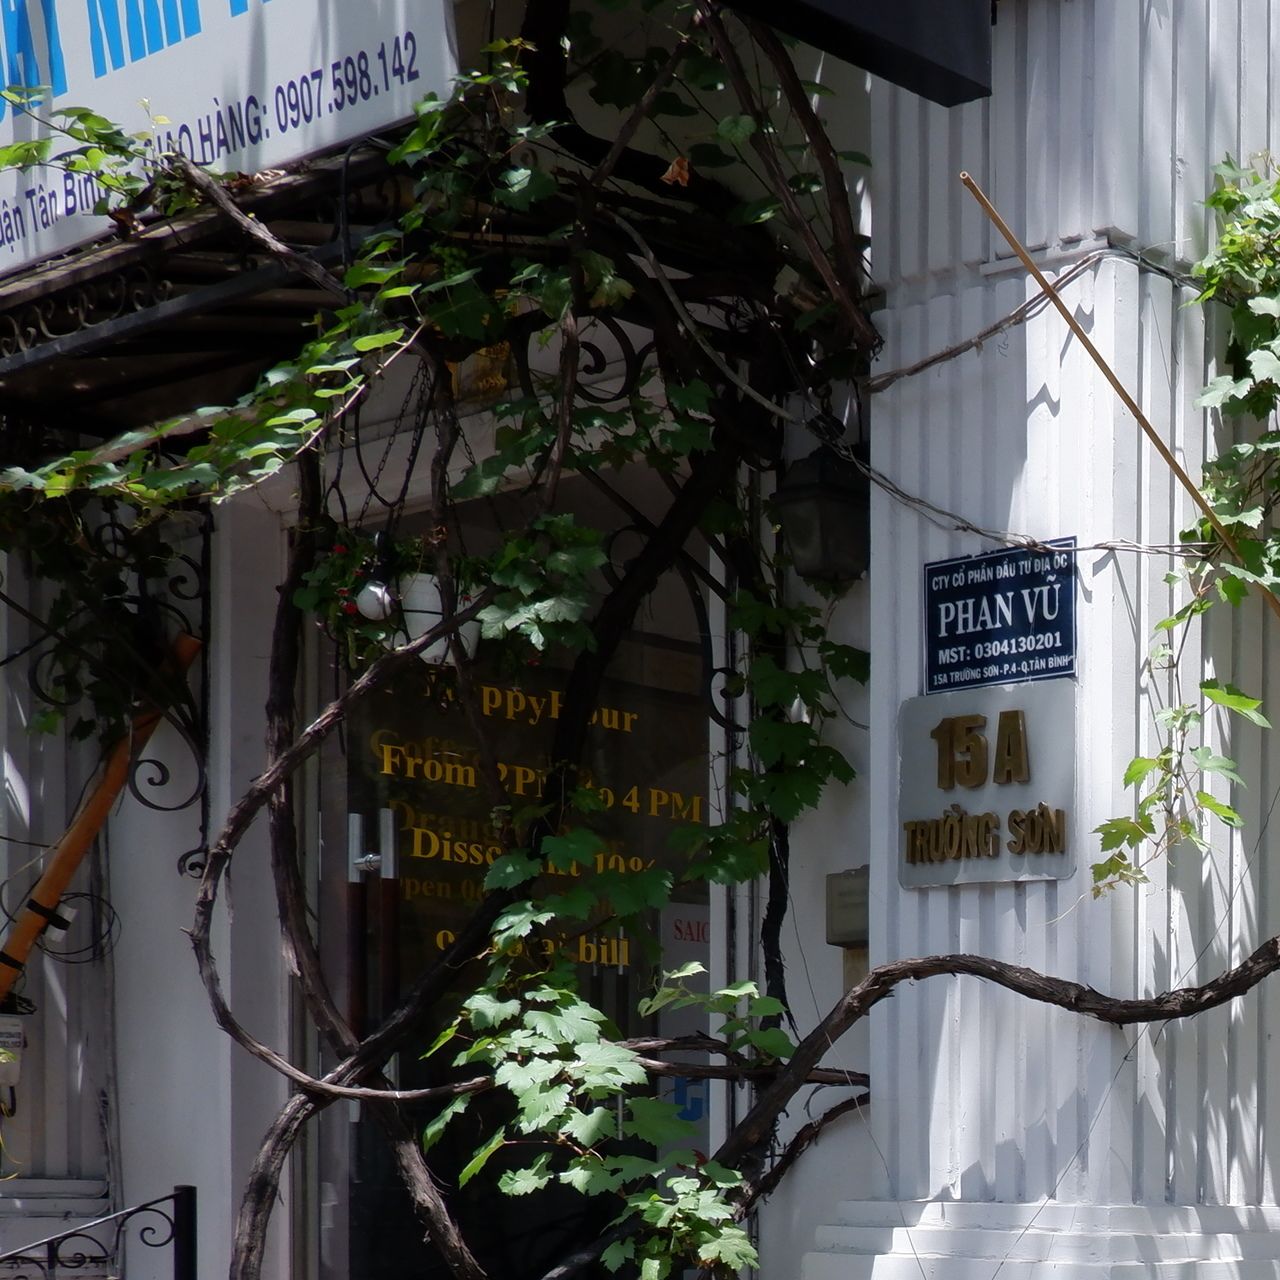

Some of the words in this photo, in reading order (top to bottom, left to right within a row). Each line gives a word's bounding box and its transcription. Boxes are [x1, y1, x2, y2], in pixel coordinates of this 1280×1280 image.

[275, 31, 419, 133] 0907.598.142
[26, 184, 58, 232] Tân
[932, 576, 949, 591] CTY
[968, 562, 994, 585] PHẦN
[996, 558, 1016, 580] ĐẦU
[1034, 557, 1051, 576] ĐỊA
[938, 592, 1014, 638] PHAN
[1021, 575, 1061, 624] VŨ
[938, 646, 971, 665] MST:
[975, 631, 1062, 659] 0304130201
[933, 674, 948, 686] 15A
[379, 743, 477, 788] From
[1007, 800, 1065, 856] SƠN
[579, 933, 631, 967] bill
